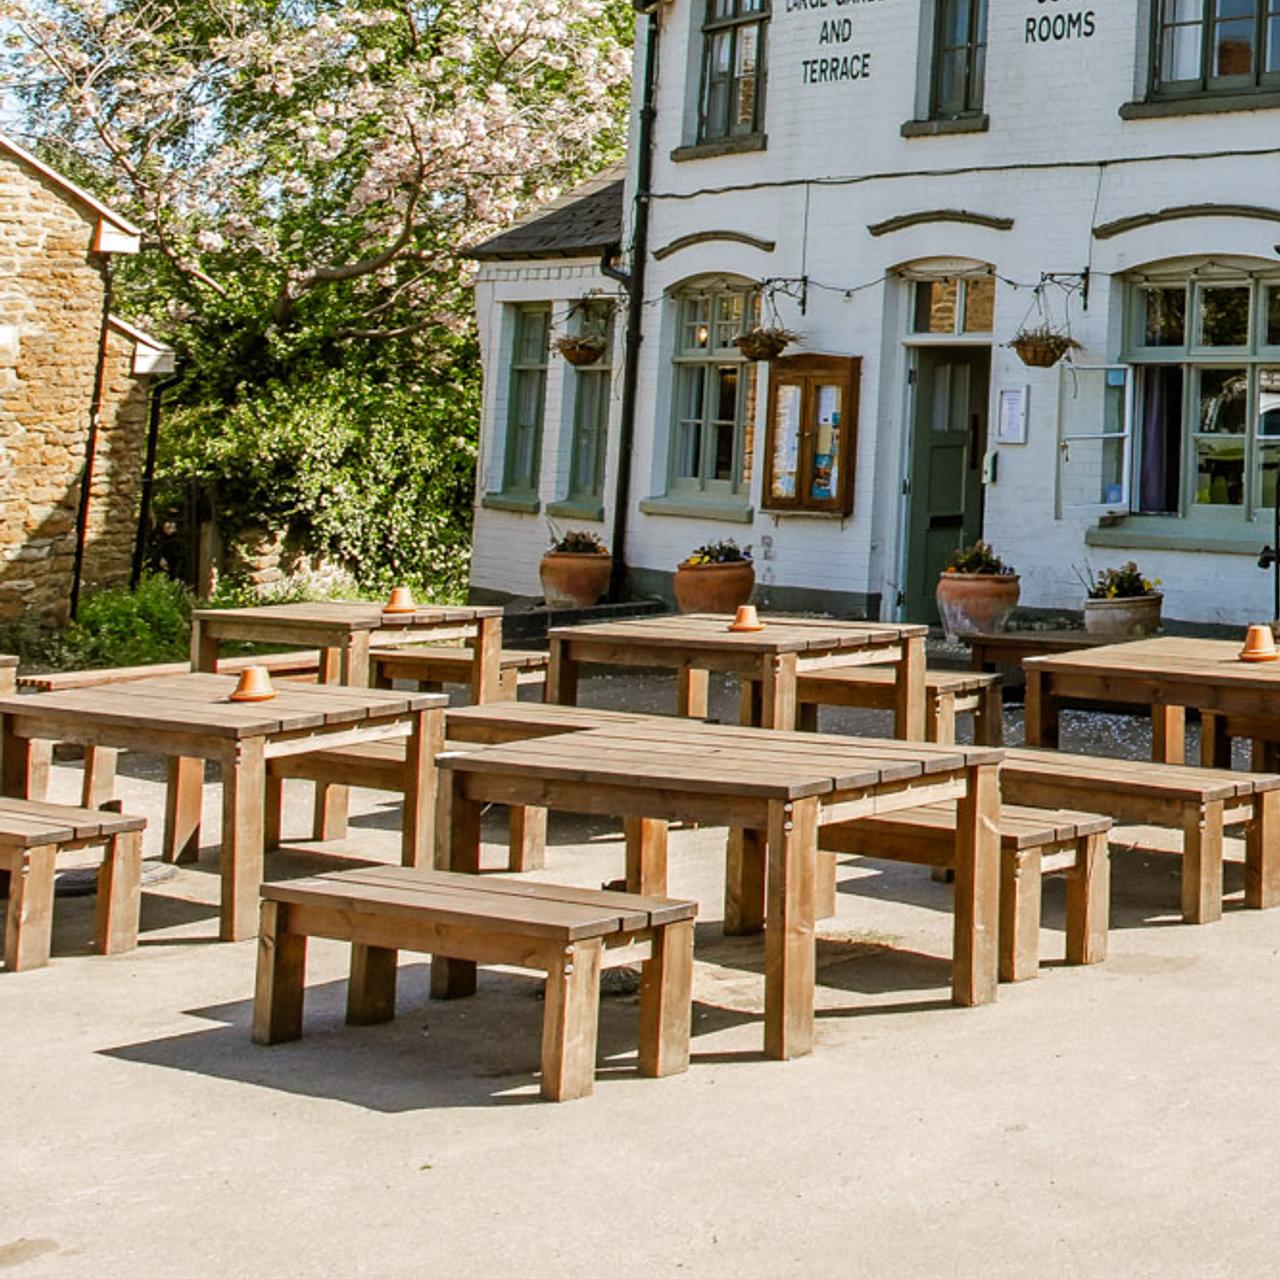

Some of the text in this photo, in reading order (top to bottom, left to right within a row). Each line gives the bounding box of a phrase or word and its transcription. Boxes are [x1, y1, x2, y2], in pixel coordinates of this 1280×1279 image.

[819, 18, 852, 44] AND
[1025, 11, 1096, 44] ROOMS
[802, 53, 871, 84] TERRACE
